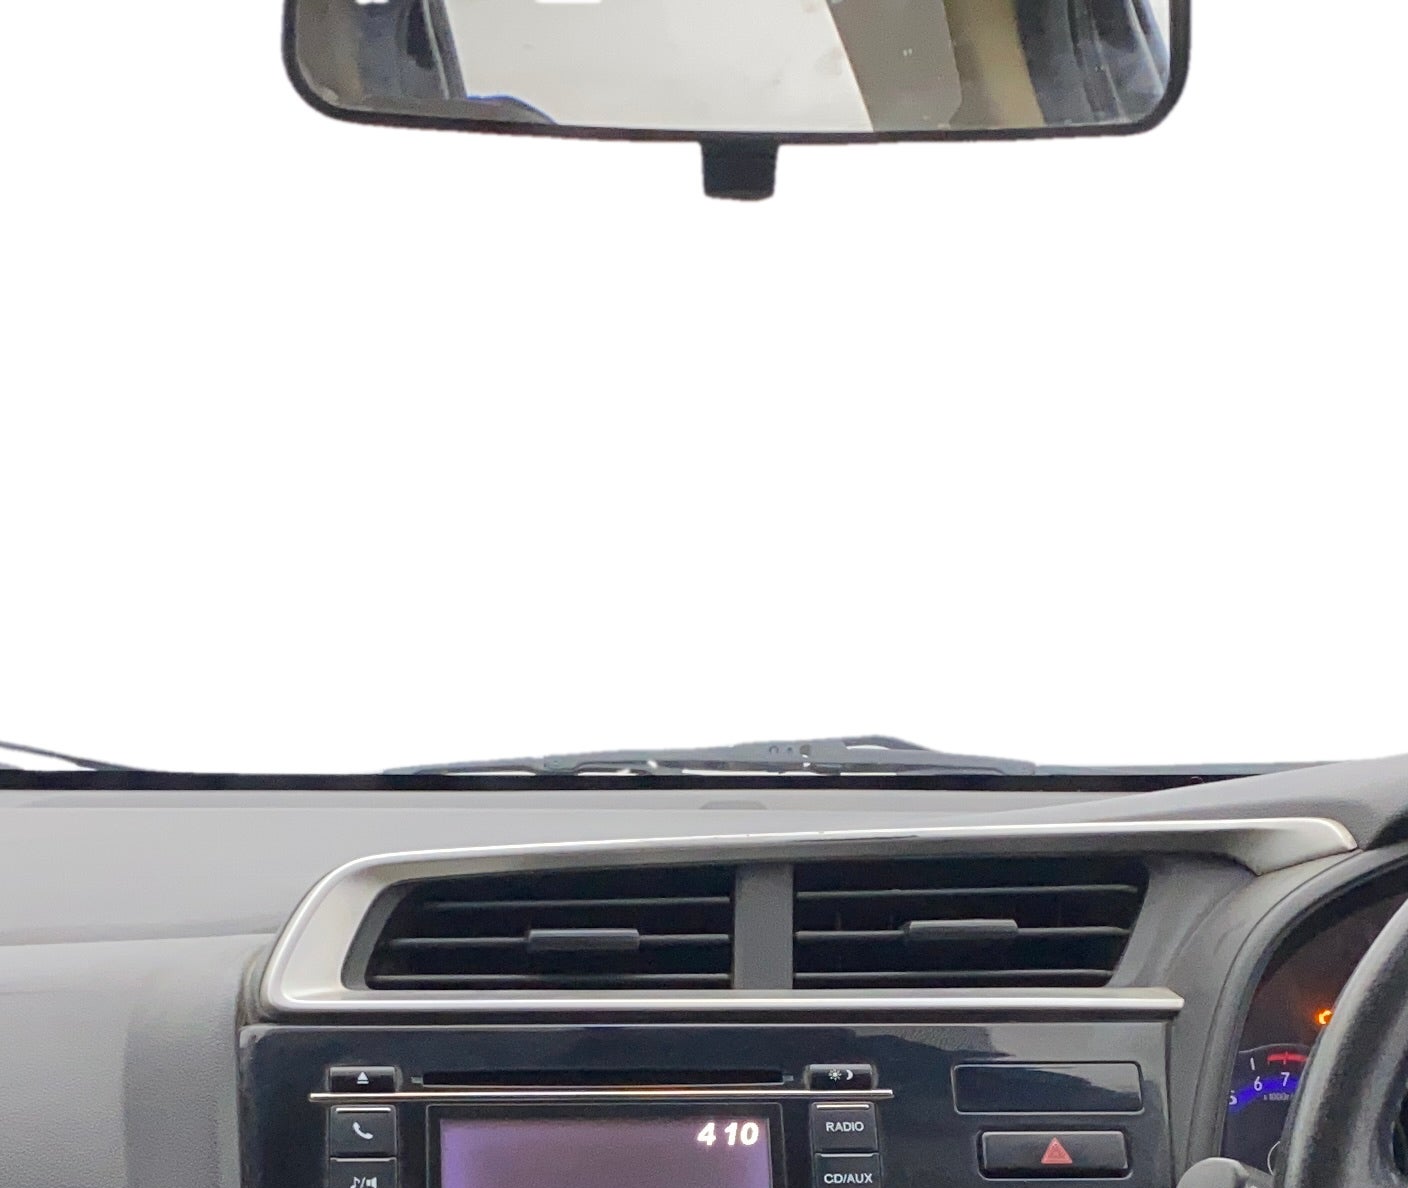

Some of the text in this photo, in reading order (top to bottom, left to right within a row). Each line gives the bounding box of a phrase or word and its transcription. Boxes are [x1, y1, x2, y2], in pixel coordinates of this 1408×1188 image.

[1253, 1075, 1263, 1092] 6
[1280, 1071, 1290, 1087] 7
[825, 1121, 865, 1133] RADIO
[823, 1173, 873, 1185] CD/AUX
